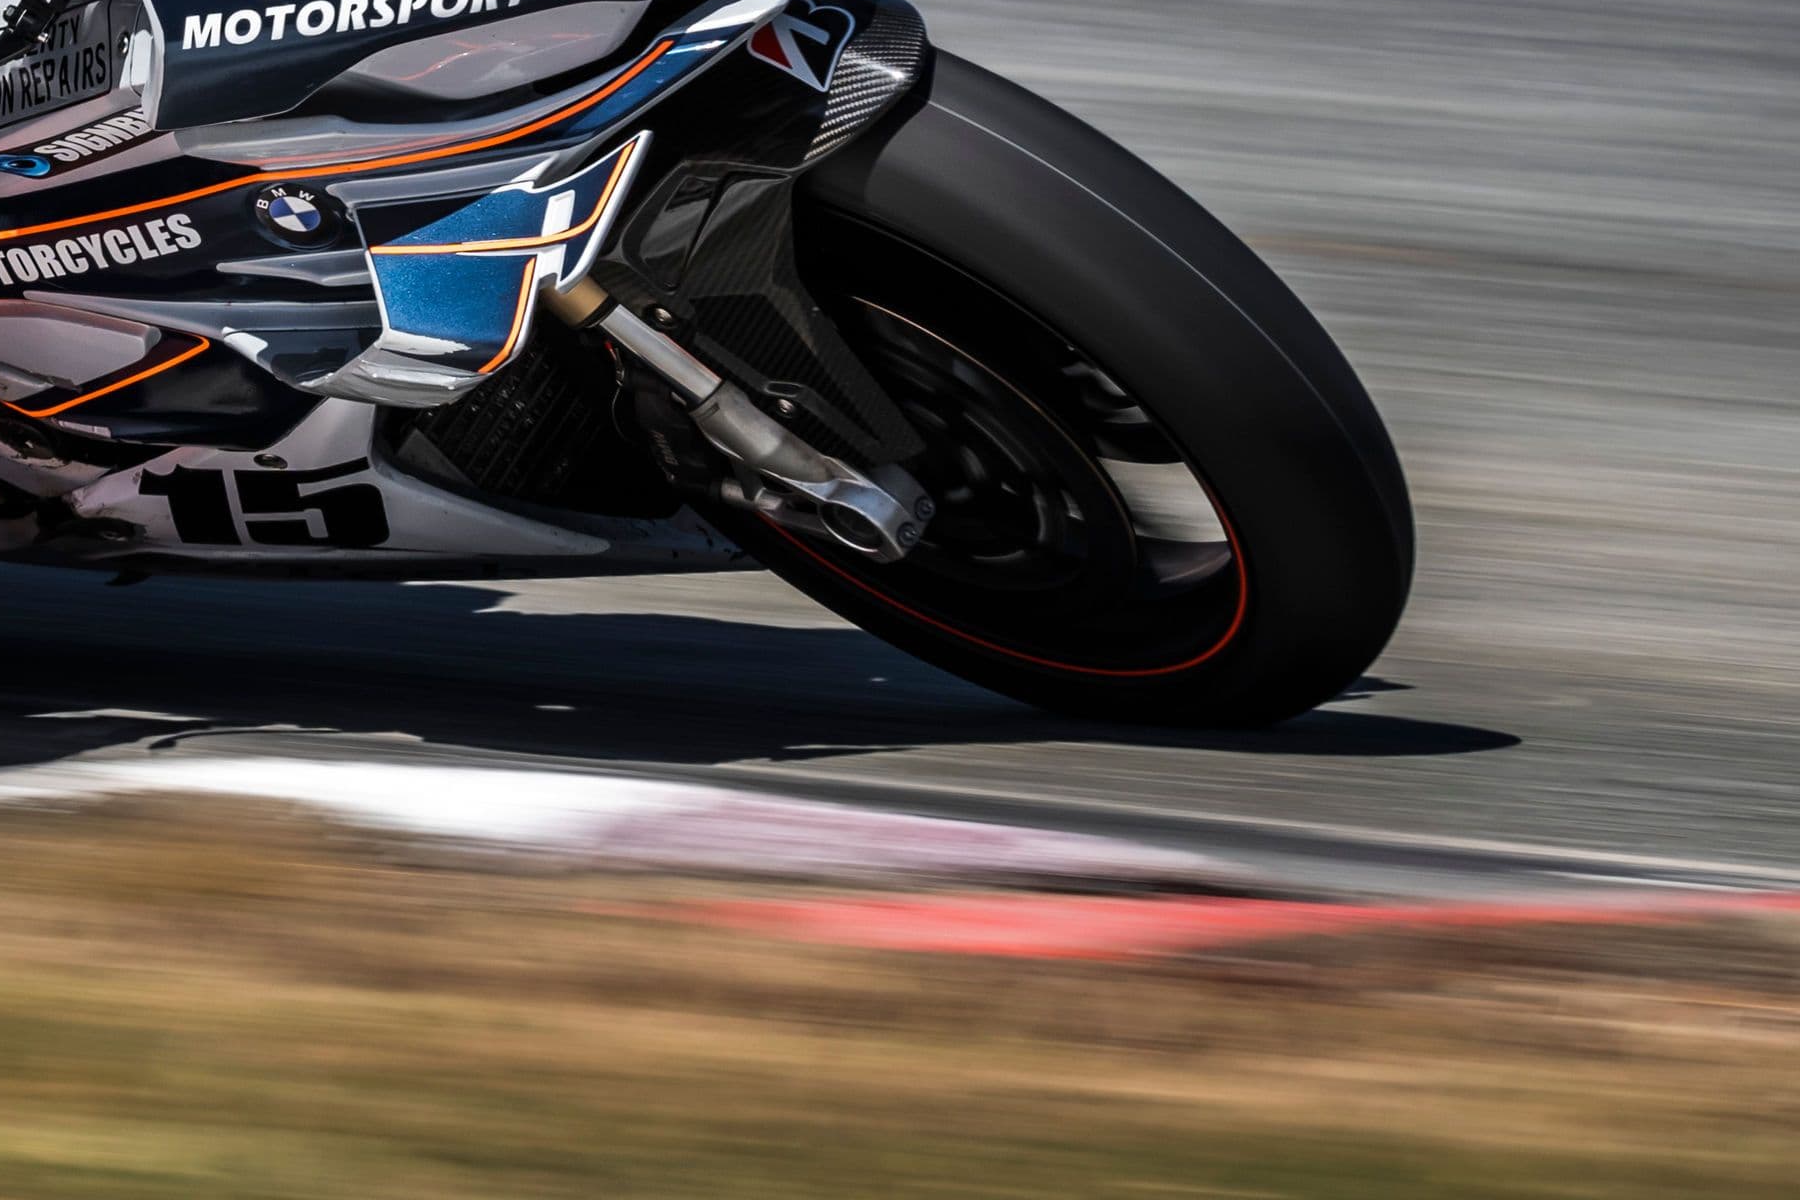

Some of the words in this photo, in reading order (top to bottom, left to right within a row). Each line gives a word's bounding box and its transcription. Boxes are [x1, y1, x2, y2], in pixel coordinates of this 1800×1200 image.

[19, 40, 106, 110] REPAIRS
[256, 187, 315, 210] BMW
[138, 457, 392, 547] 15
